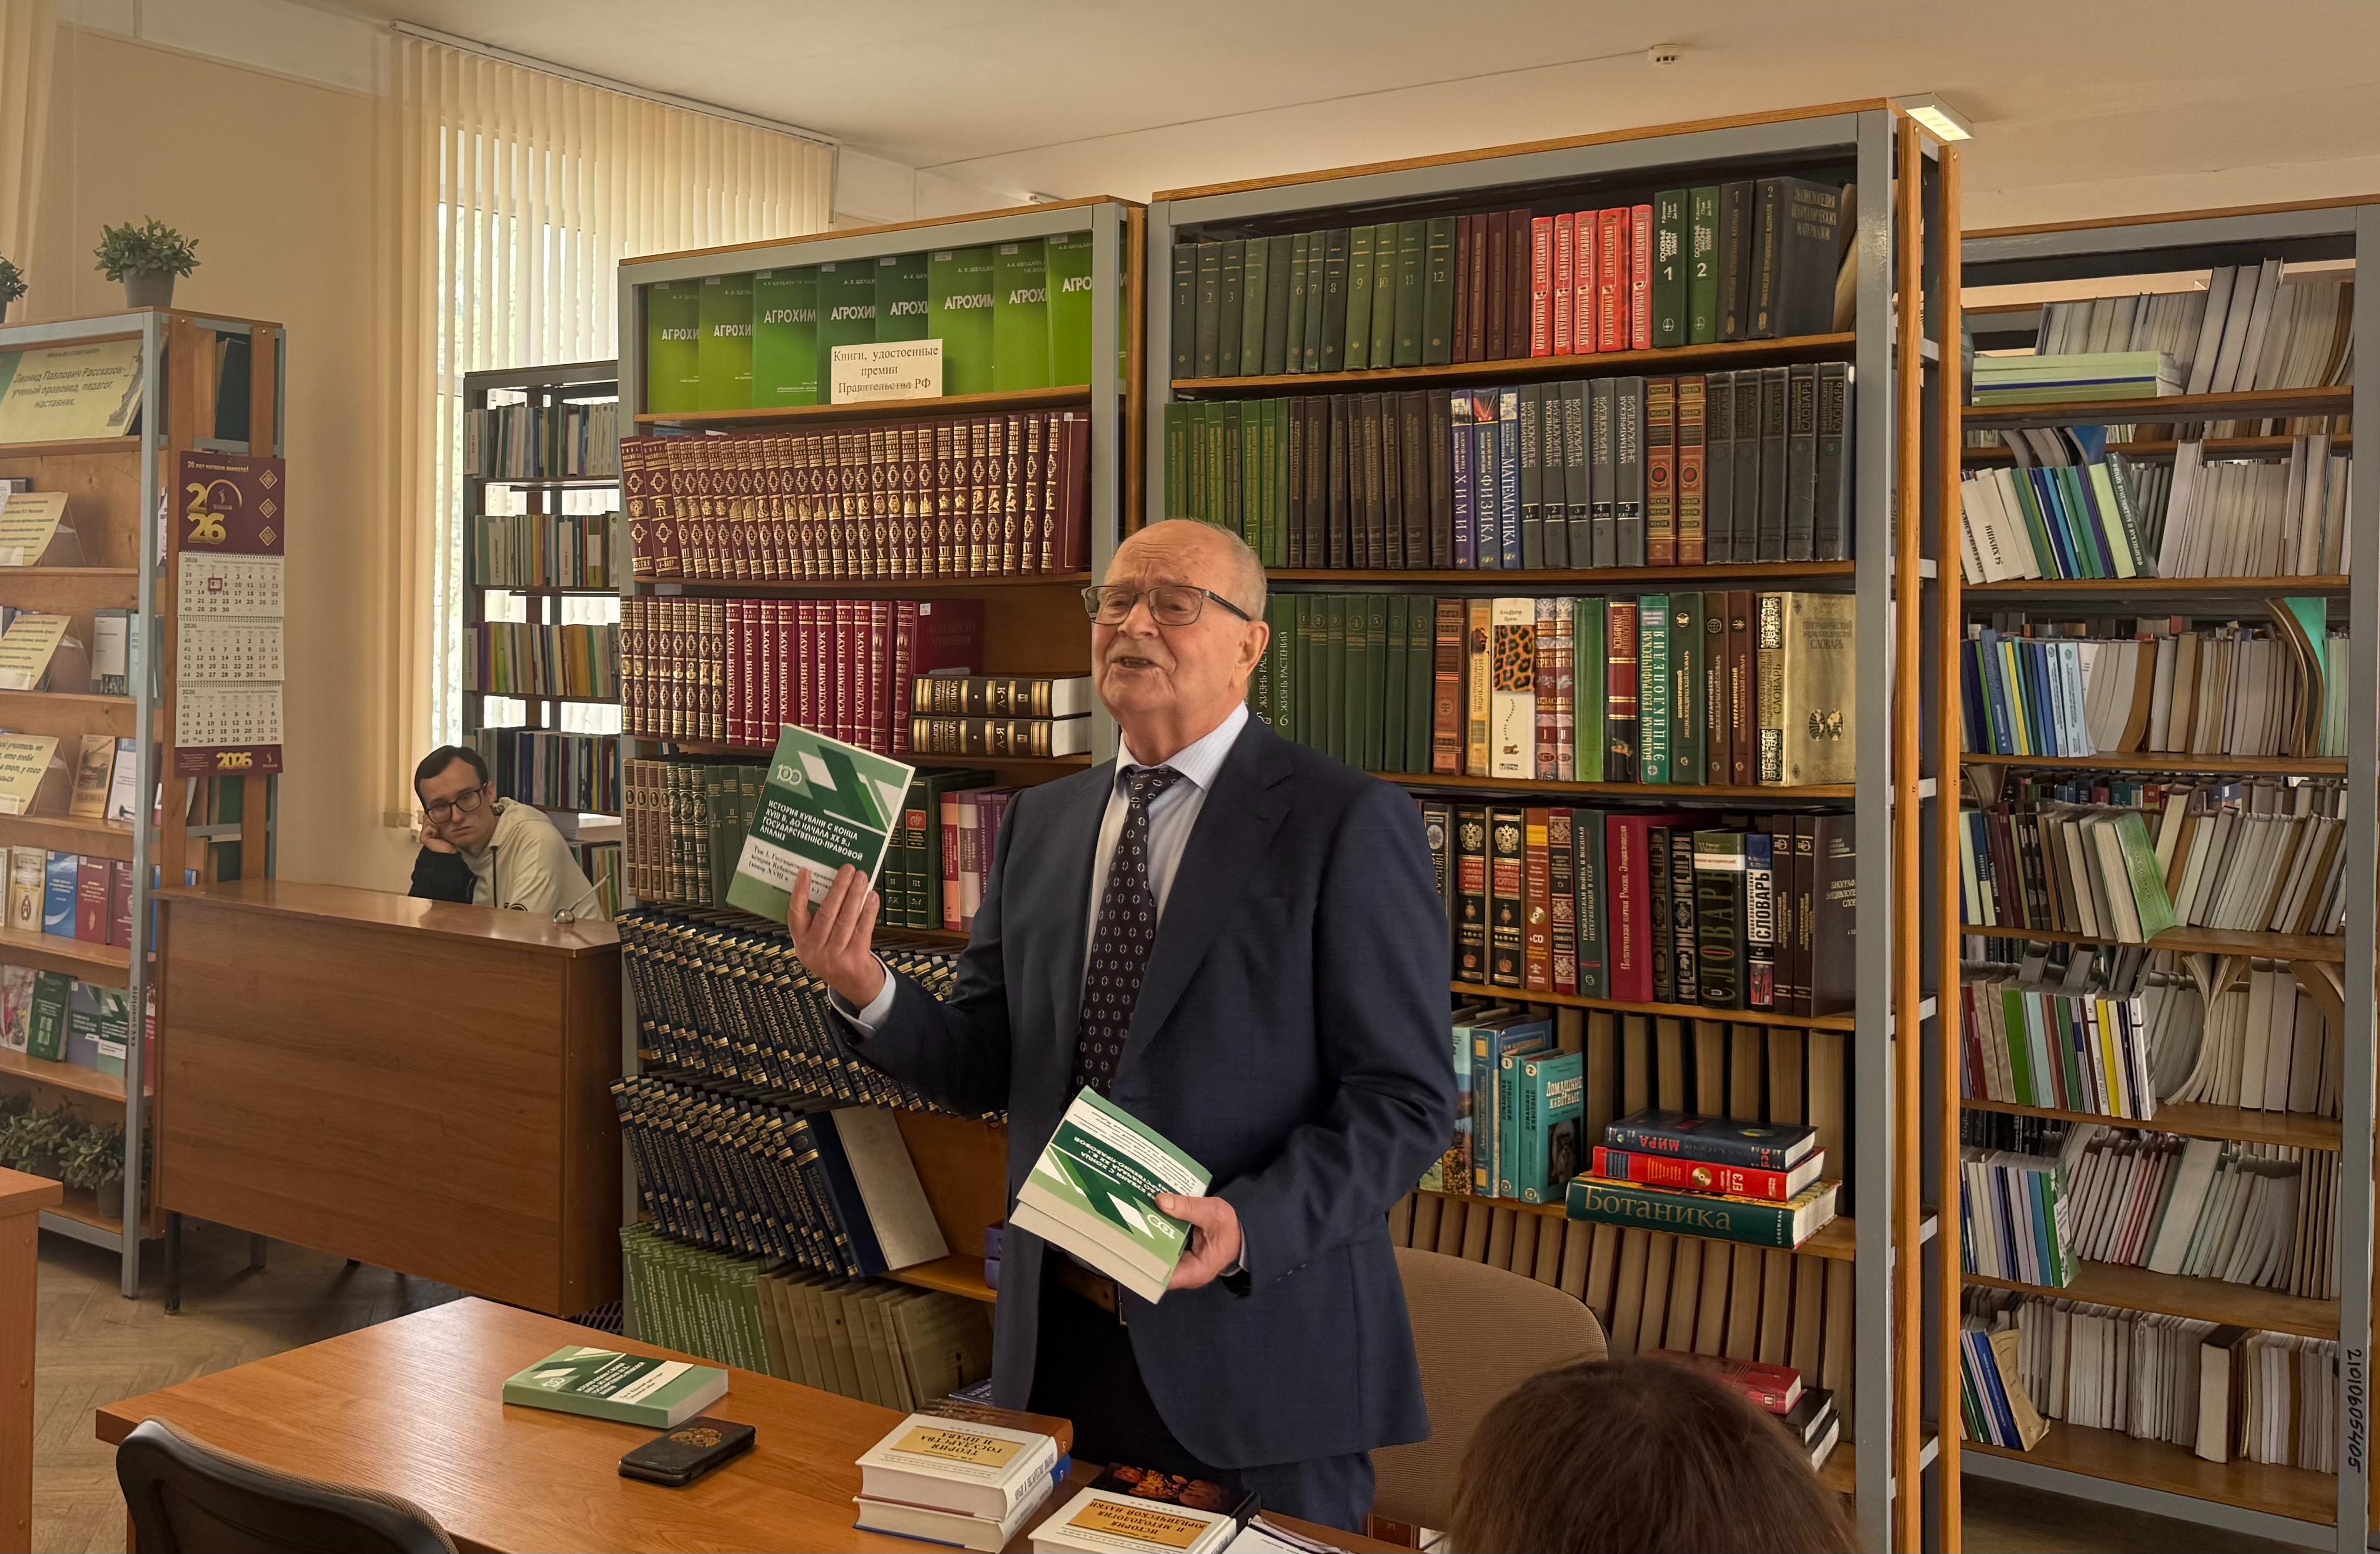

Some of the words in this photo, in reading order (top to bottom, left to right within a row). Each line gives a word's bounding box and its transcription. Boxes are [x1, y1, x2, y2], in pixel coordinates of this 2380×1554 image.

[1767, 186, 1773, 198] 2
[1432, 271, 1445, 283] 12
[1664, 266, 1672, 280] 1
[1697, 263, 1707, 277] 2
[1062, 276, 1092, 293] АГРО
[1330, 283, 1337, 294] 8
[1355, 278, 1363, 290] 9
[1378, 277, 1389, 288] 10
[1405, 274, 1414, 286] 11
[1206, 292, 1213, 303] 2
[1228, 291, 1234, 303] 3
[1296, 284, 1303, 296] 6
[1311, 284, 1317, 296] 7
[1180, 294, 1186, 306] 1
[764, 308, 817, 324] АГРОХИМ
[662, 328, 699, 340] АГРОХИ
[714, 324, 753, 337] АГРОХИ
[834, 351, 867, 361] Книги,
[873, 347, 938, 361] удостоенные
[14, 374, 42, 384] Леонид
[42, 371, 81, 381] Павлович
[861, 365, 898, 378] премии
[839, 381, 912, 395] Правительства
[915, 378, 931, 388] РФ
[1801, 381, 1811, 431] СЛОВАРЬ
[1833, 381, 1843, 431] СЛОВАРЬ
[1528, 401, 1536, 467] ЭНЦИКЛОПЕДИЯ
[1553, 400, 1561, 466] ЭНЦИКЛОПЕДИЯ
[1565, 400, 1574, 466] МАТЕМАТИЧЕСКАЯ
[1573, 399, 1583, 466] ЭНЦИКЛОПЕДИЯ
[1627, 395, 1636, 463] ЭНЦИКЛОПЕДИЯ
[1455, 475, 1466, 542] ХИМИЯ
[1481, 475, 1493, 543] ФИЗИКА
[1502, 458, 1515, 547] МАТЕМАТИКА
[1985, 525, 1999, 555] ХИМИЯ
[1810, 639, 1844, 649] СЛОВАРЬ
[1642, 630, 1652, 711] ГЕОГРАФИЧЕСКАЯ
[837, 662, 845, 719] АКАДЕМИЯ
[1654, 630, 1665, 761] ЭНЦИКЛОПЕДИЯ
[1773, 664, 1782, 714] СЛОВАРЬ
[1280, 714, 1288, 726] 6
[1642, 717, 1652, 761] БОЛЬШАЯ
[801, 820, 829, 840] НАЧАЛА
[827, 822, 833, 831] С
[833, 823, 858, 841] КОНЦА
[1755, 872, 1771, 939] СЛОВАРЬ
[1700, 871, 1736, 1002] СЛОВАРЬ
[1639, 1135, 1680, 1153] МИРА
[1733, 1173, 1744, 1191] ЕГЭ
[1584, 1185, 1731, 1231] Ботаника
[2347, 1349, 2364, 1474] 21010605405
[921, 1435, 1003, 1454] ГОСУДАРСТВА
[941, 1432, 980, 1444] ПРАВА
[930, 1443, 979, 1456] ТЕОРИЯ
[1089, 1502, 1123, 1513] НАУКИ
[1097, 1511, 1171, 1530] МЕТОДОЛОГИЯ
[1126, 1509, 1206, 1529] ЮРИДИЧЕСКОЙ
[1111, 1521, 1158, 1535] ИСТОРИЯ
